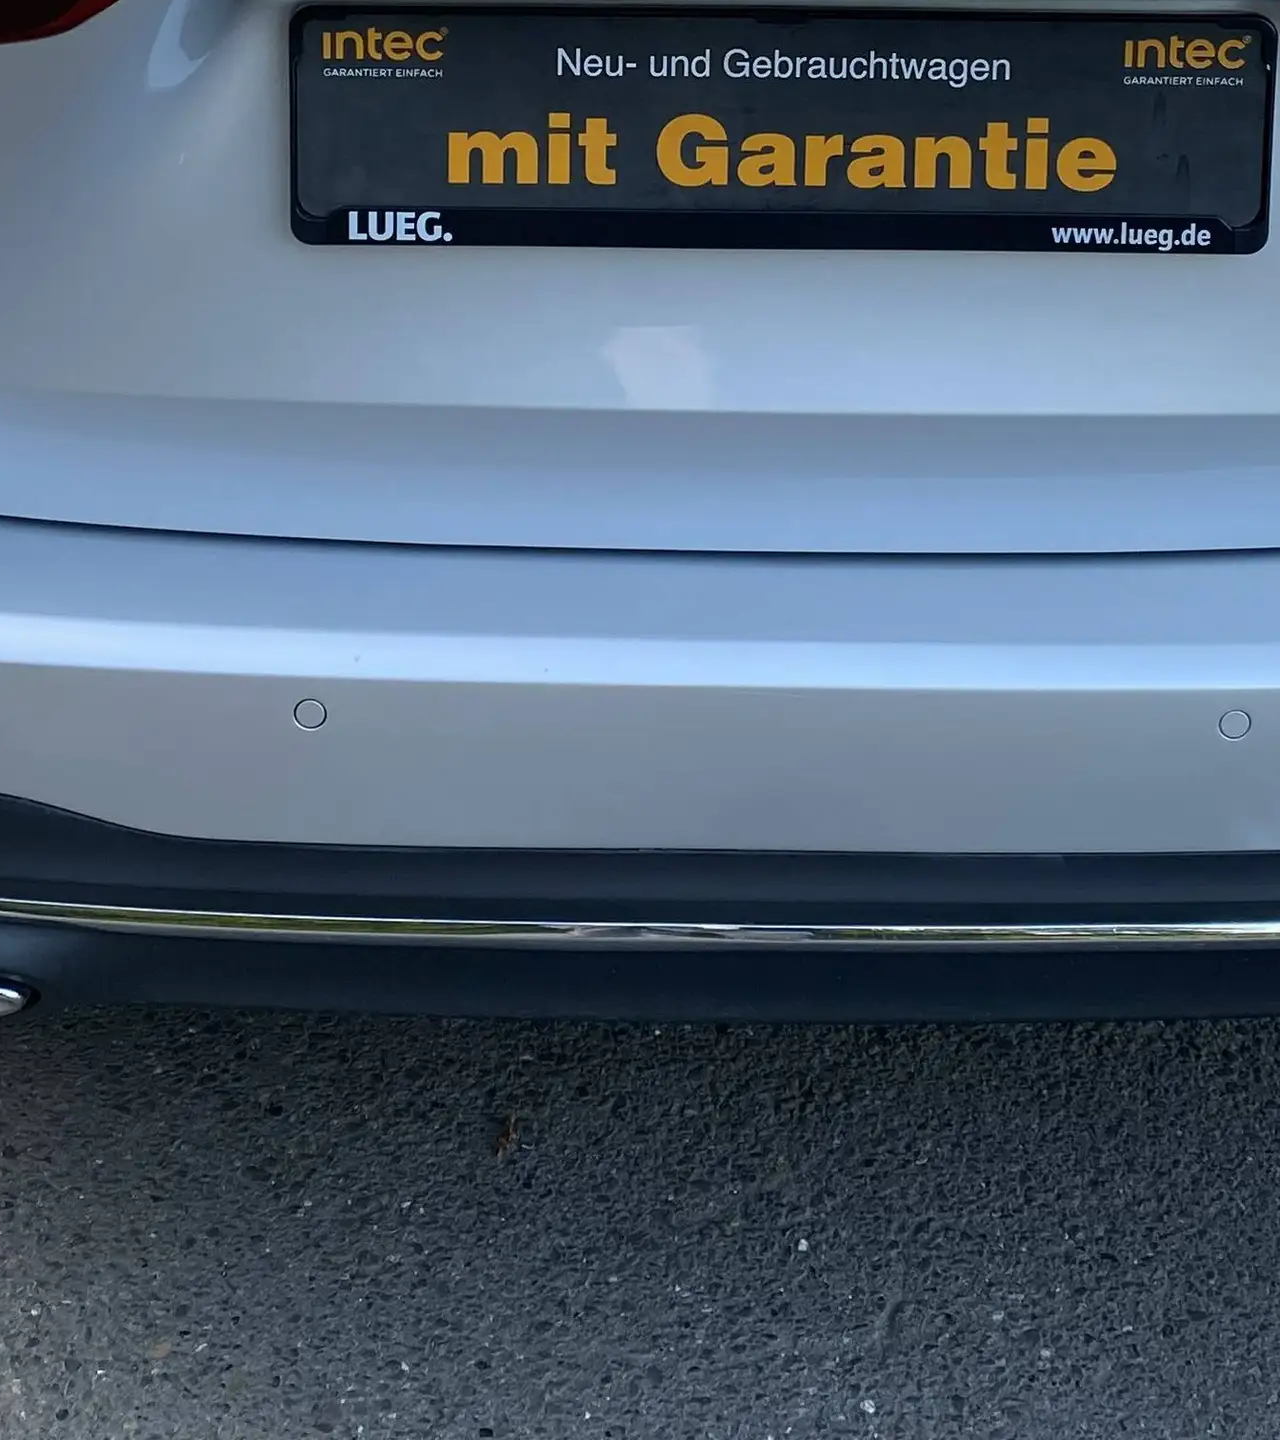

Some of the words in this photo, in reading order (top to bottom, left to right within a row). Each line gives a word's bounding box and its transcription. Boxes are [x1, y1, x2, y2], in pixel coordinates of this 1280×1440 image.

[322, 67, 393, 79] GARANTIERT
[395, 68, 444, 79] EINFACH
[556, 47, 638, 78] Neu-
[648, 48, 712, 79] und
[722, 48, 1012, 89] Gebrauchtwagen
[1123, 75, 1194, 87] GARANTIERT
[1195, 76, 1244, 87] EINFACH
[447, 112, 618, 185] mit
[656, 112, 1118, 192] Garantie
[348, 210, 454, 243] LUEG.
[1051, 222, 1212, 251] www.lueg.de
